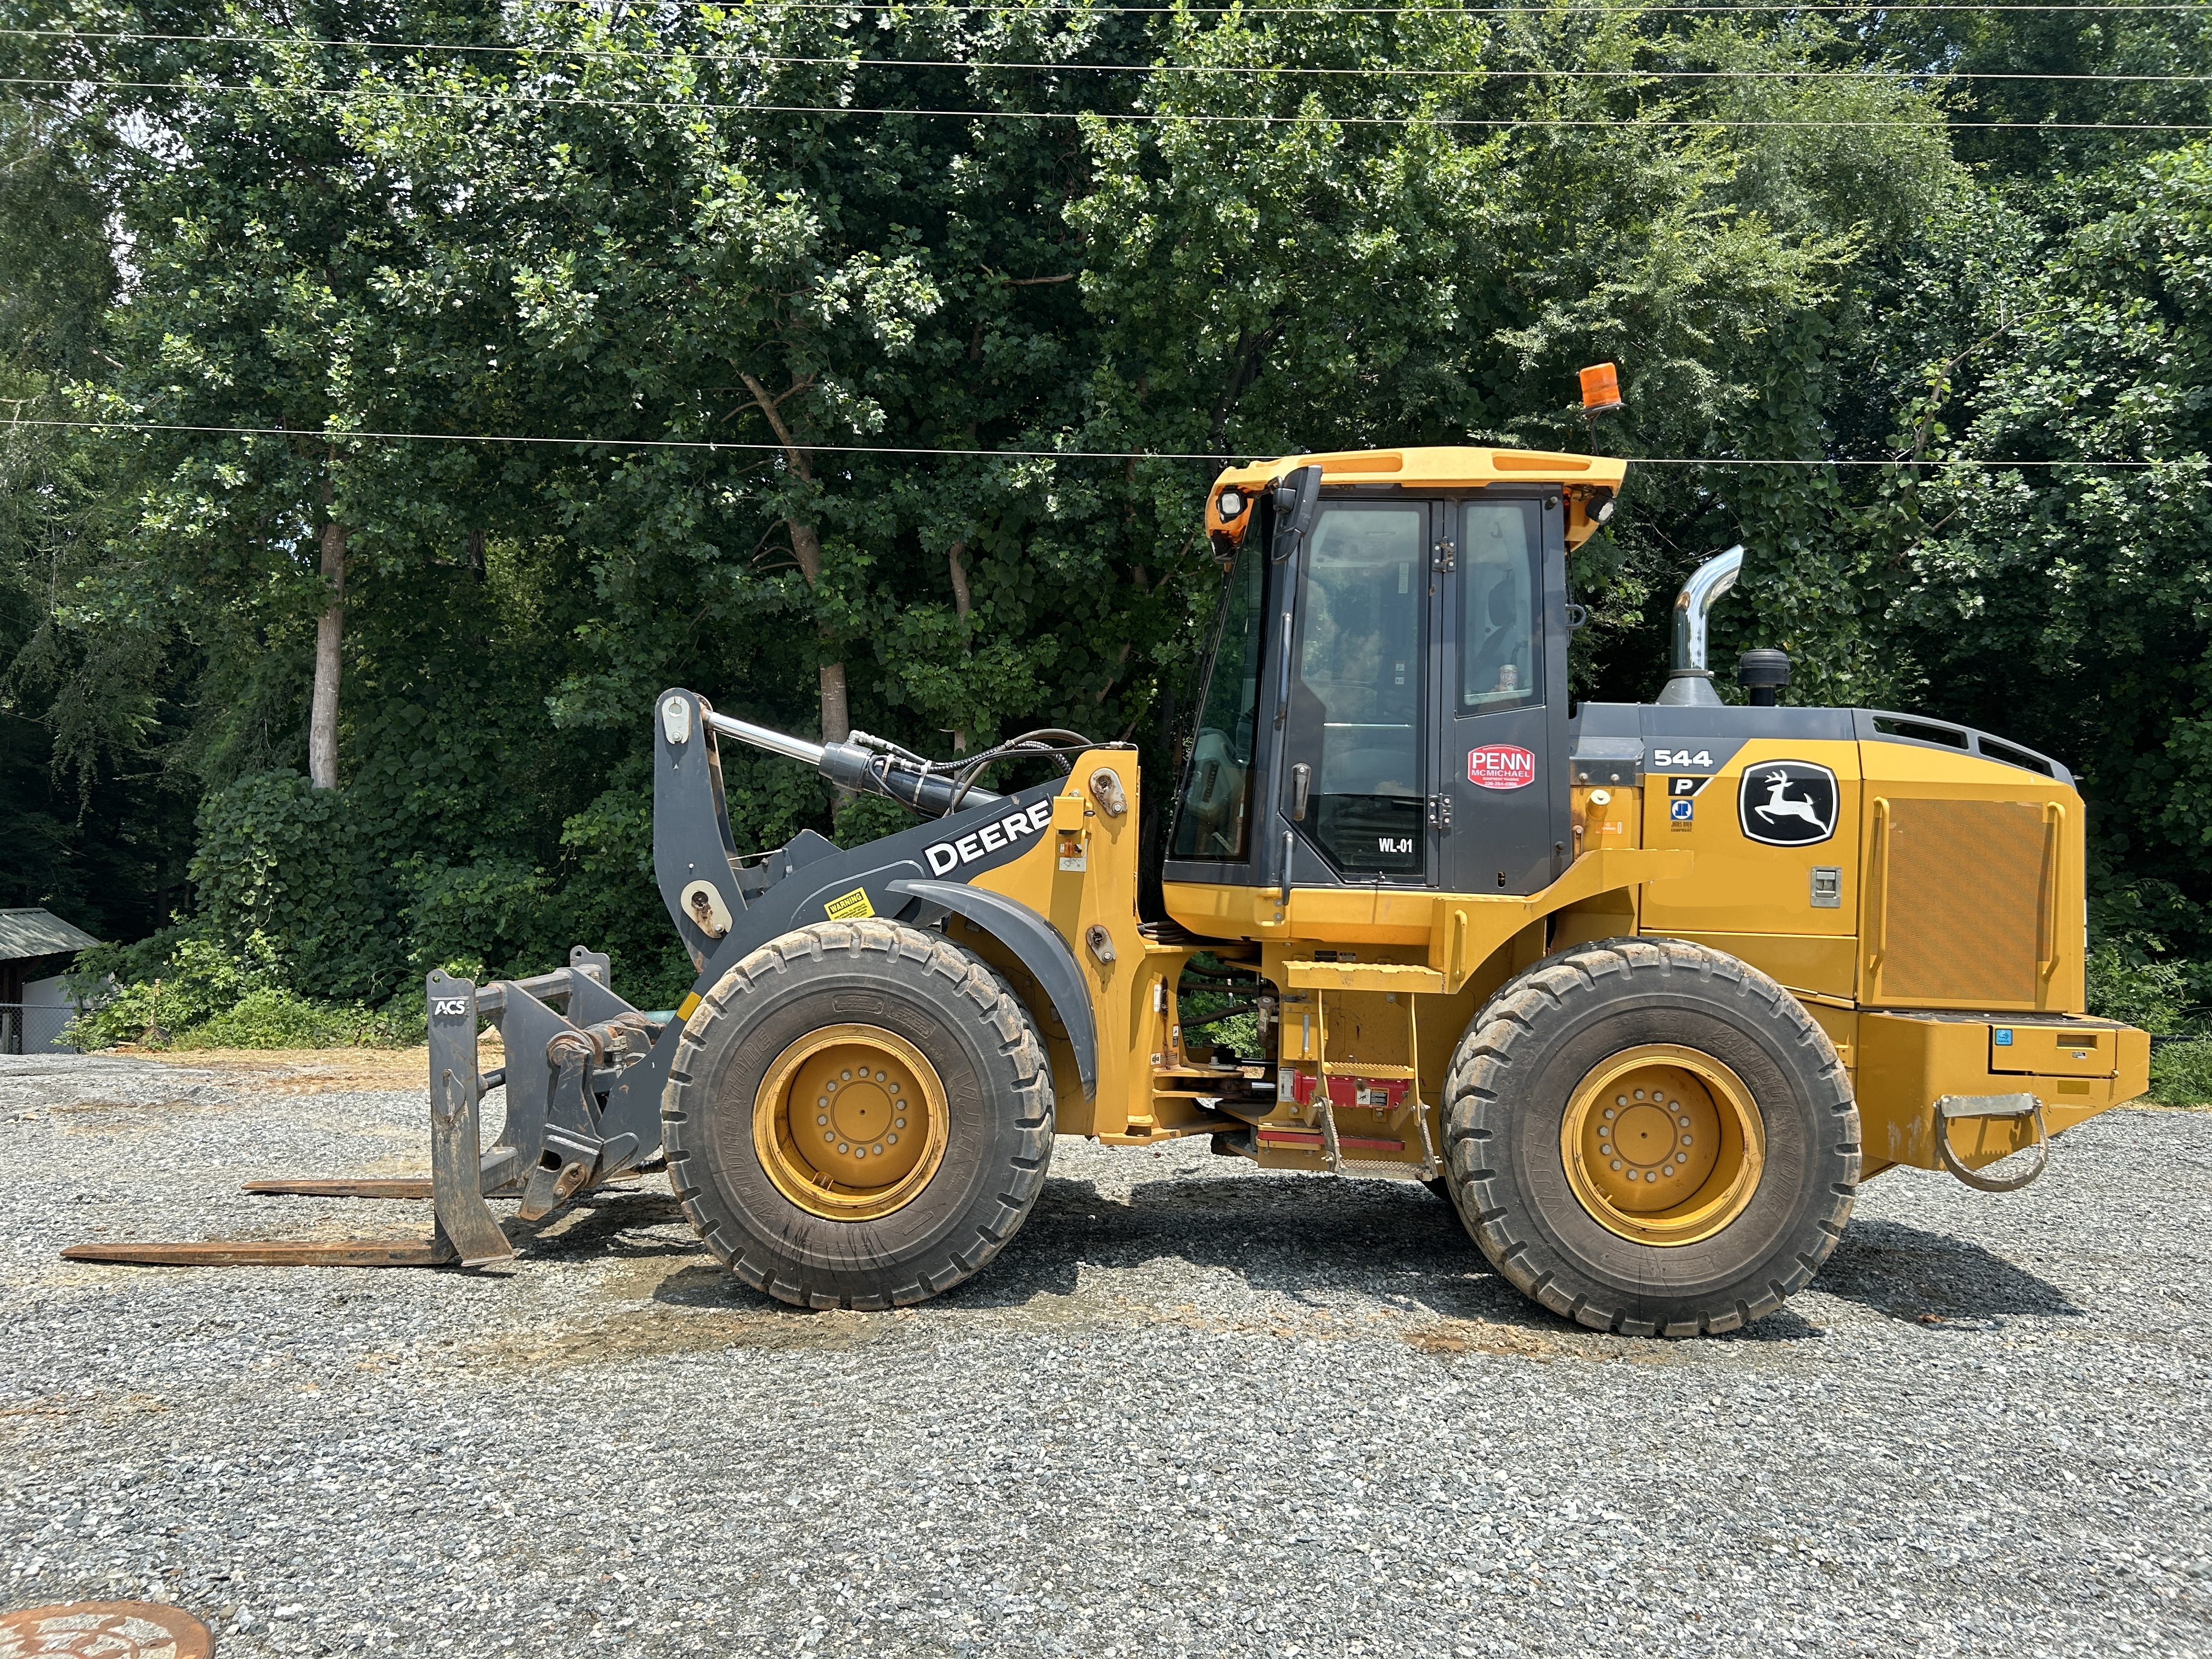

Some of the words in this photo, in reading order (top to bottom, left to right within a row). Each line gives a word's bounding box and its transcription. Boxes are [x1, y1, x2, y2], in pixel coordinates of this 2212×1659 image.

[1472, 752, 1531, 770] PENN
[1654, 749, 1713, 767] 544
[1471, 769, 1530, 777] MCMICHAEL
[1675, 779, 1693, 794] P
[925, 799, 1052, 877] DEERE
[1379, 838, 1413, 853] WL-01
[830, 892, 862, 913] WARNING
[435, 1000, 465, 1015] ACS
